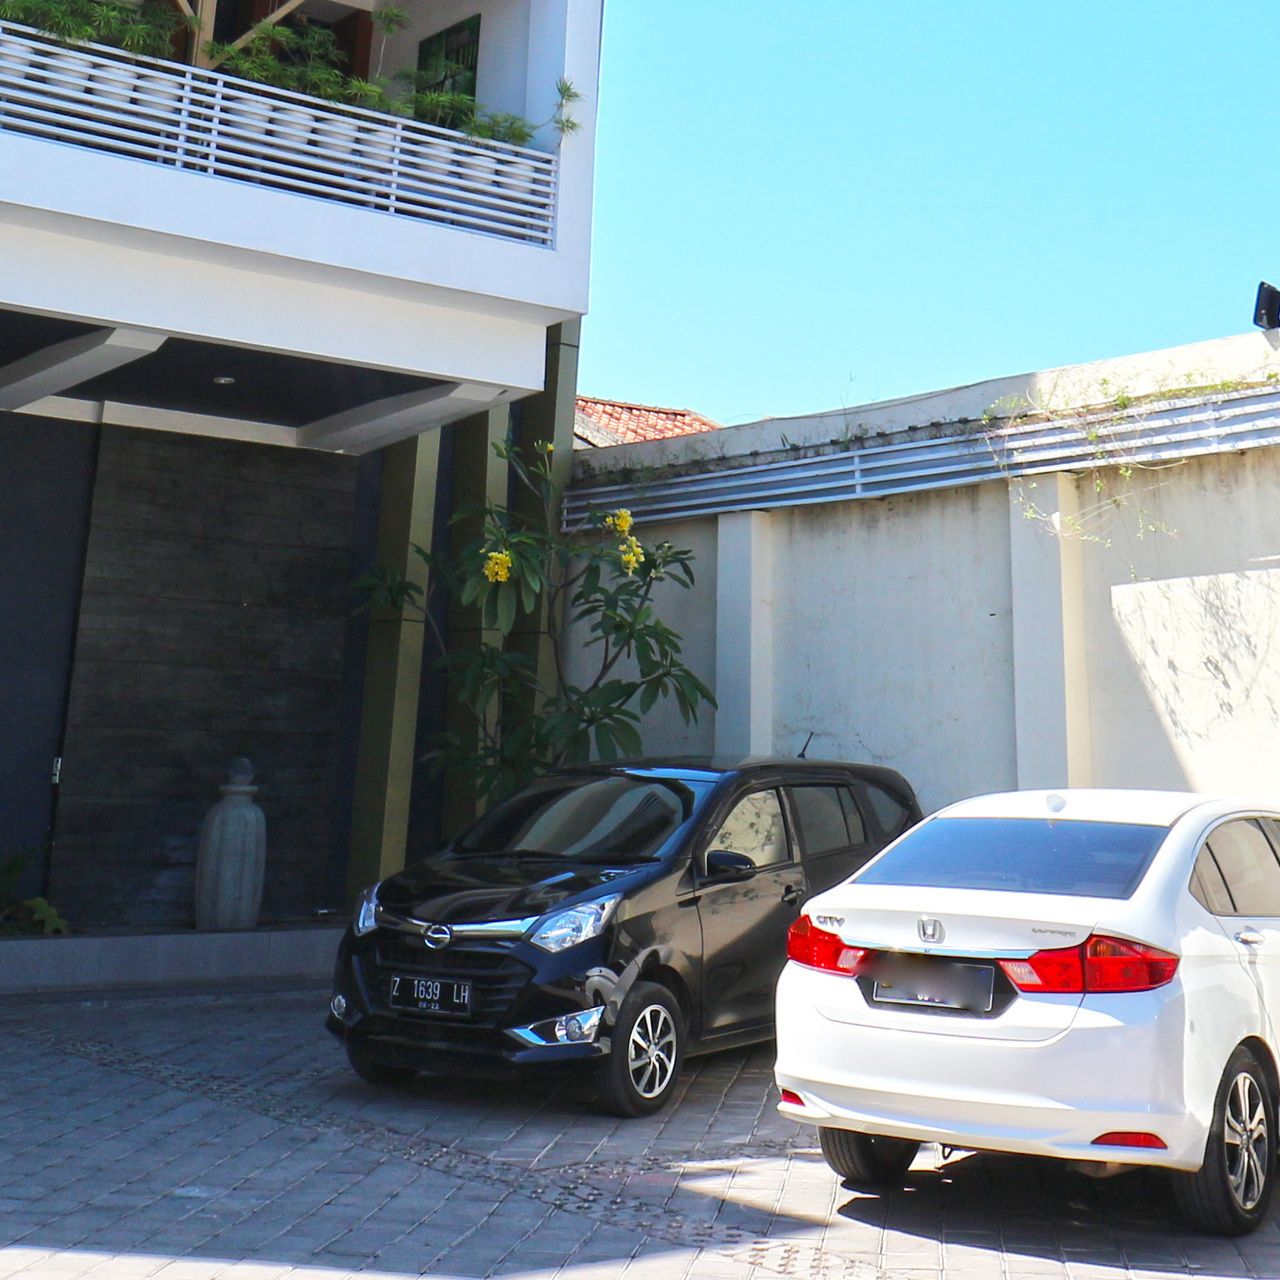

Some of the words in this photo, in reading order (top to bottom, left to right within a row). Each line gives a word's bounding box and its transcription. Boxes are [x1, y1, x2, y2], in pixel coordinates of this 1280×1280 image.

[816, 915, 847, 928] CITY
[392, 977, 401, 997] Z
[414, 979, 441, 1001] 1639
[452, 983, 470, 1005] LH
